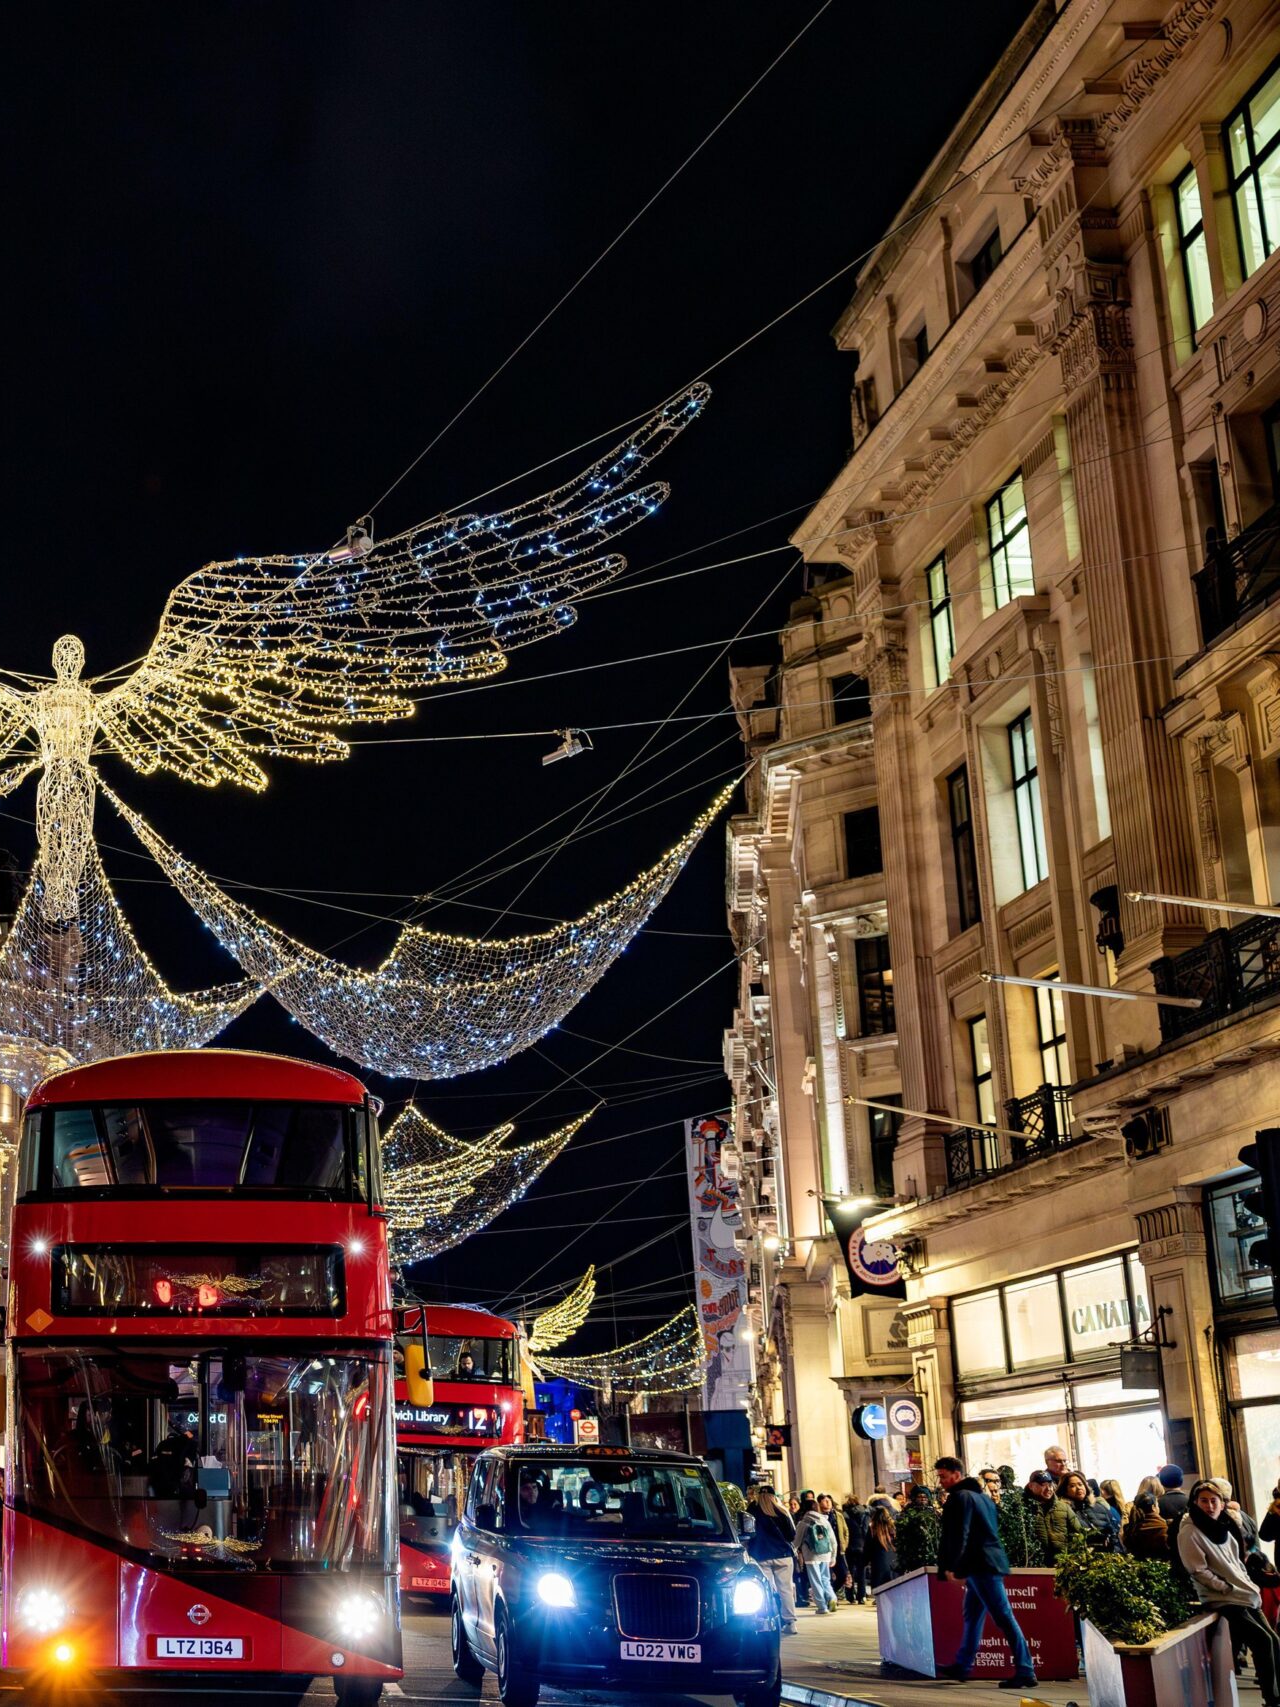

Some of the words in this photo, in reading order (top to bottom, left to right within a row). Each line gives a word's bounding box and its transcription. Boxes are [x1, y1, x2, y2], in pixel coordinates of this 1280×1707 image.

[416, 1410, 449, 1425] Library
[468, 1408, 488, 1430] 12
[166, 1640, 196, 1655] LTZ
[199, 1640, 234, 1655] 1364
[1031, 1638, 1041, 1648] by
[626, 1643, 665, 1658] LO22
[668, 1645, 696, 1660] VWG
[975, 1652, 1005, 1660] CROWN
